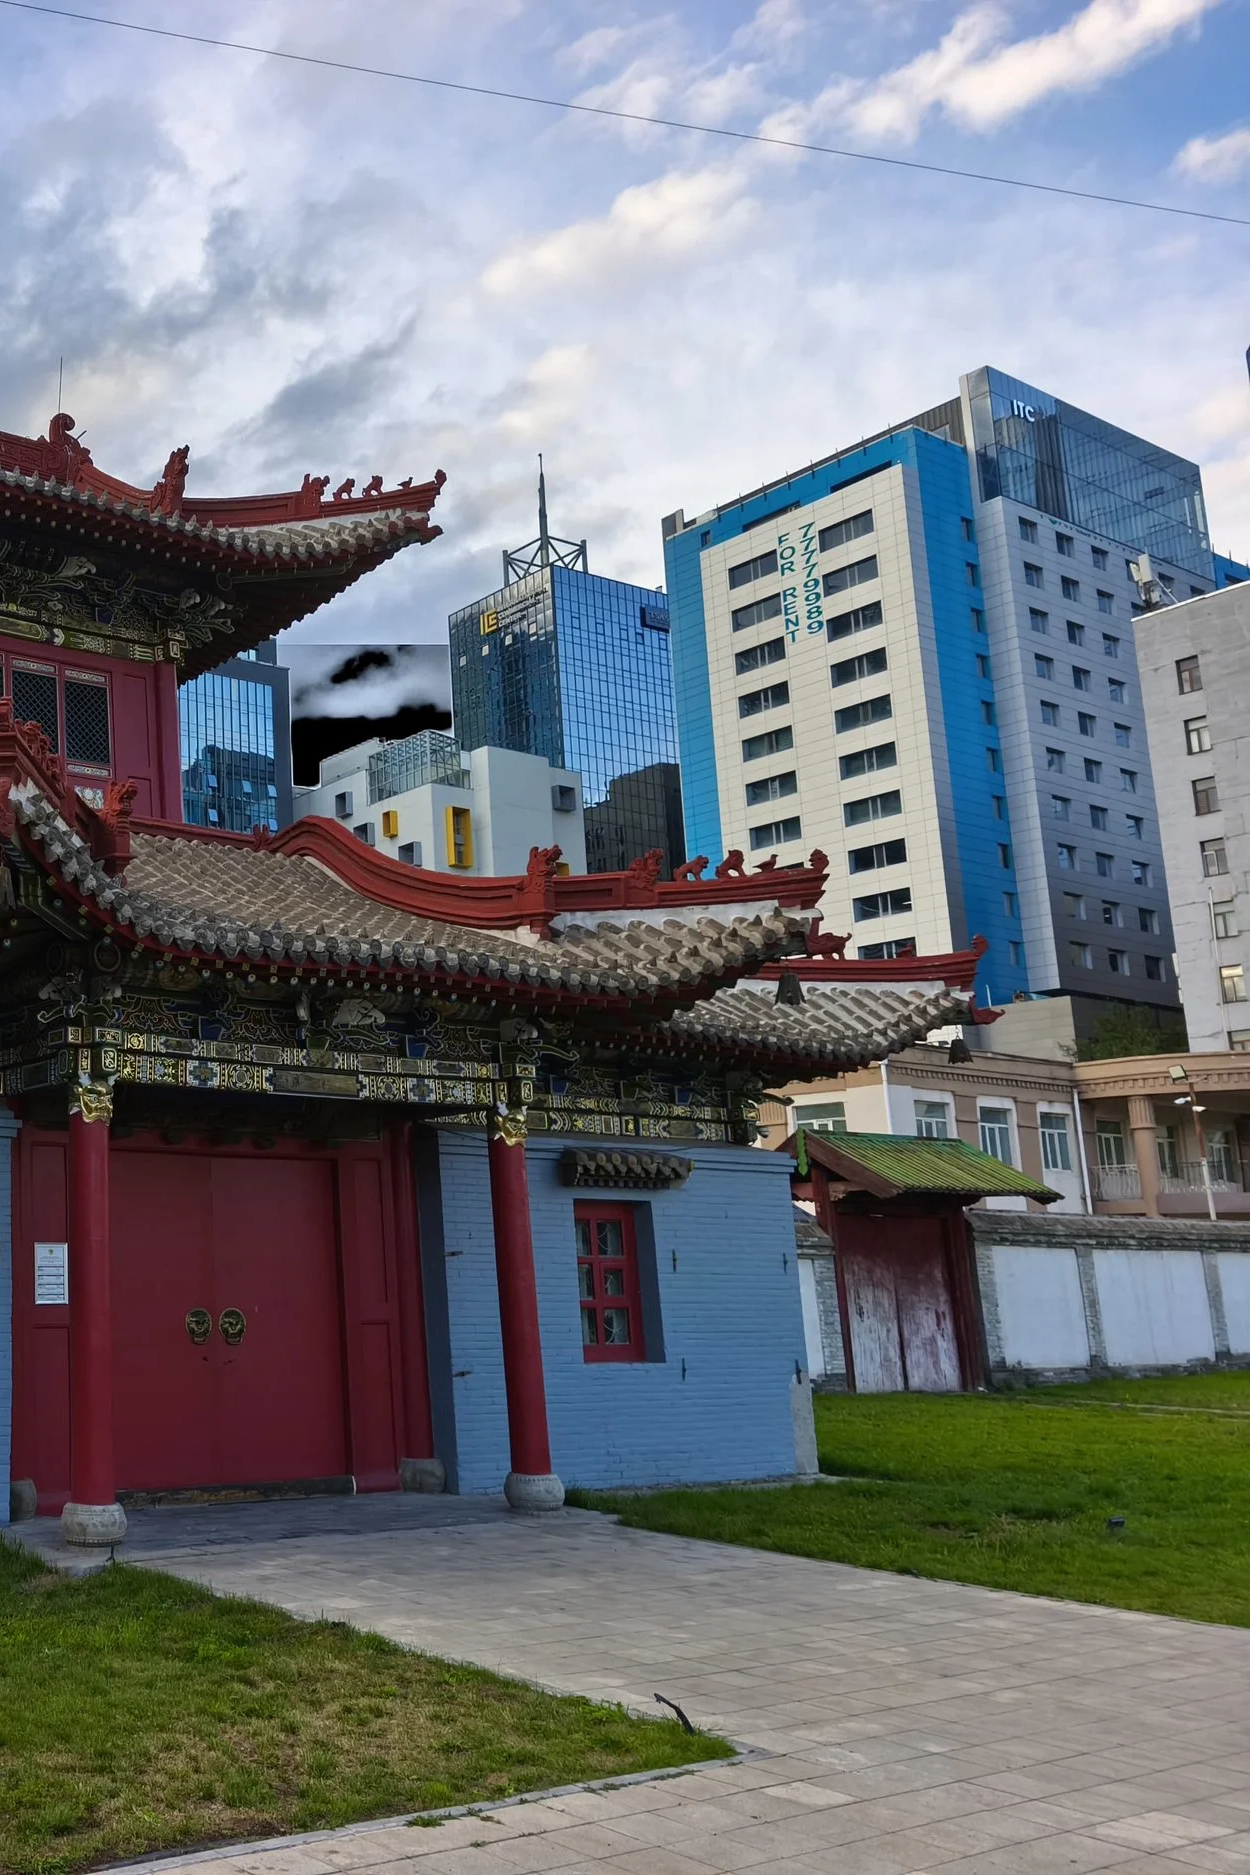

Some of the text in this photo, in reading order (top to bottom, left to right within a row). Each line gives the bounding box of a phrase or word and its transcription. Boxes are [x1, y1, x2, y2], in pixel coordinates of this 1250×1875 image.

[1013, 399, 1036, 422] ITC
[778, 532, 800, 643] FOR RENT
[798, 521, 824, 634] 77779989
